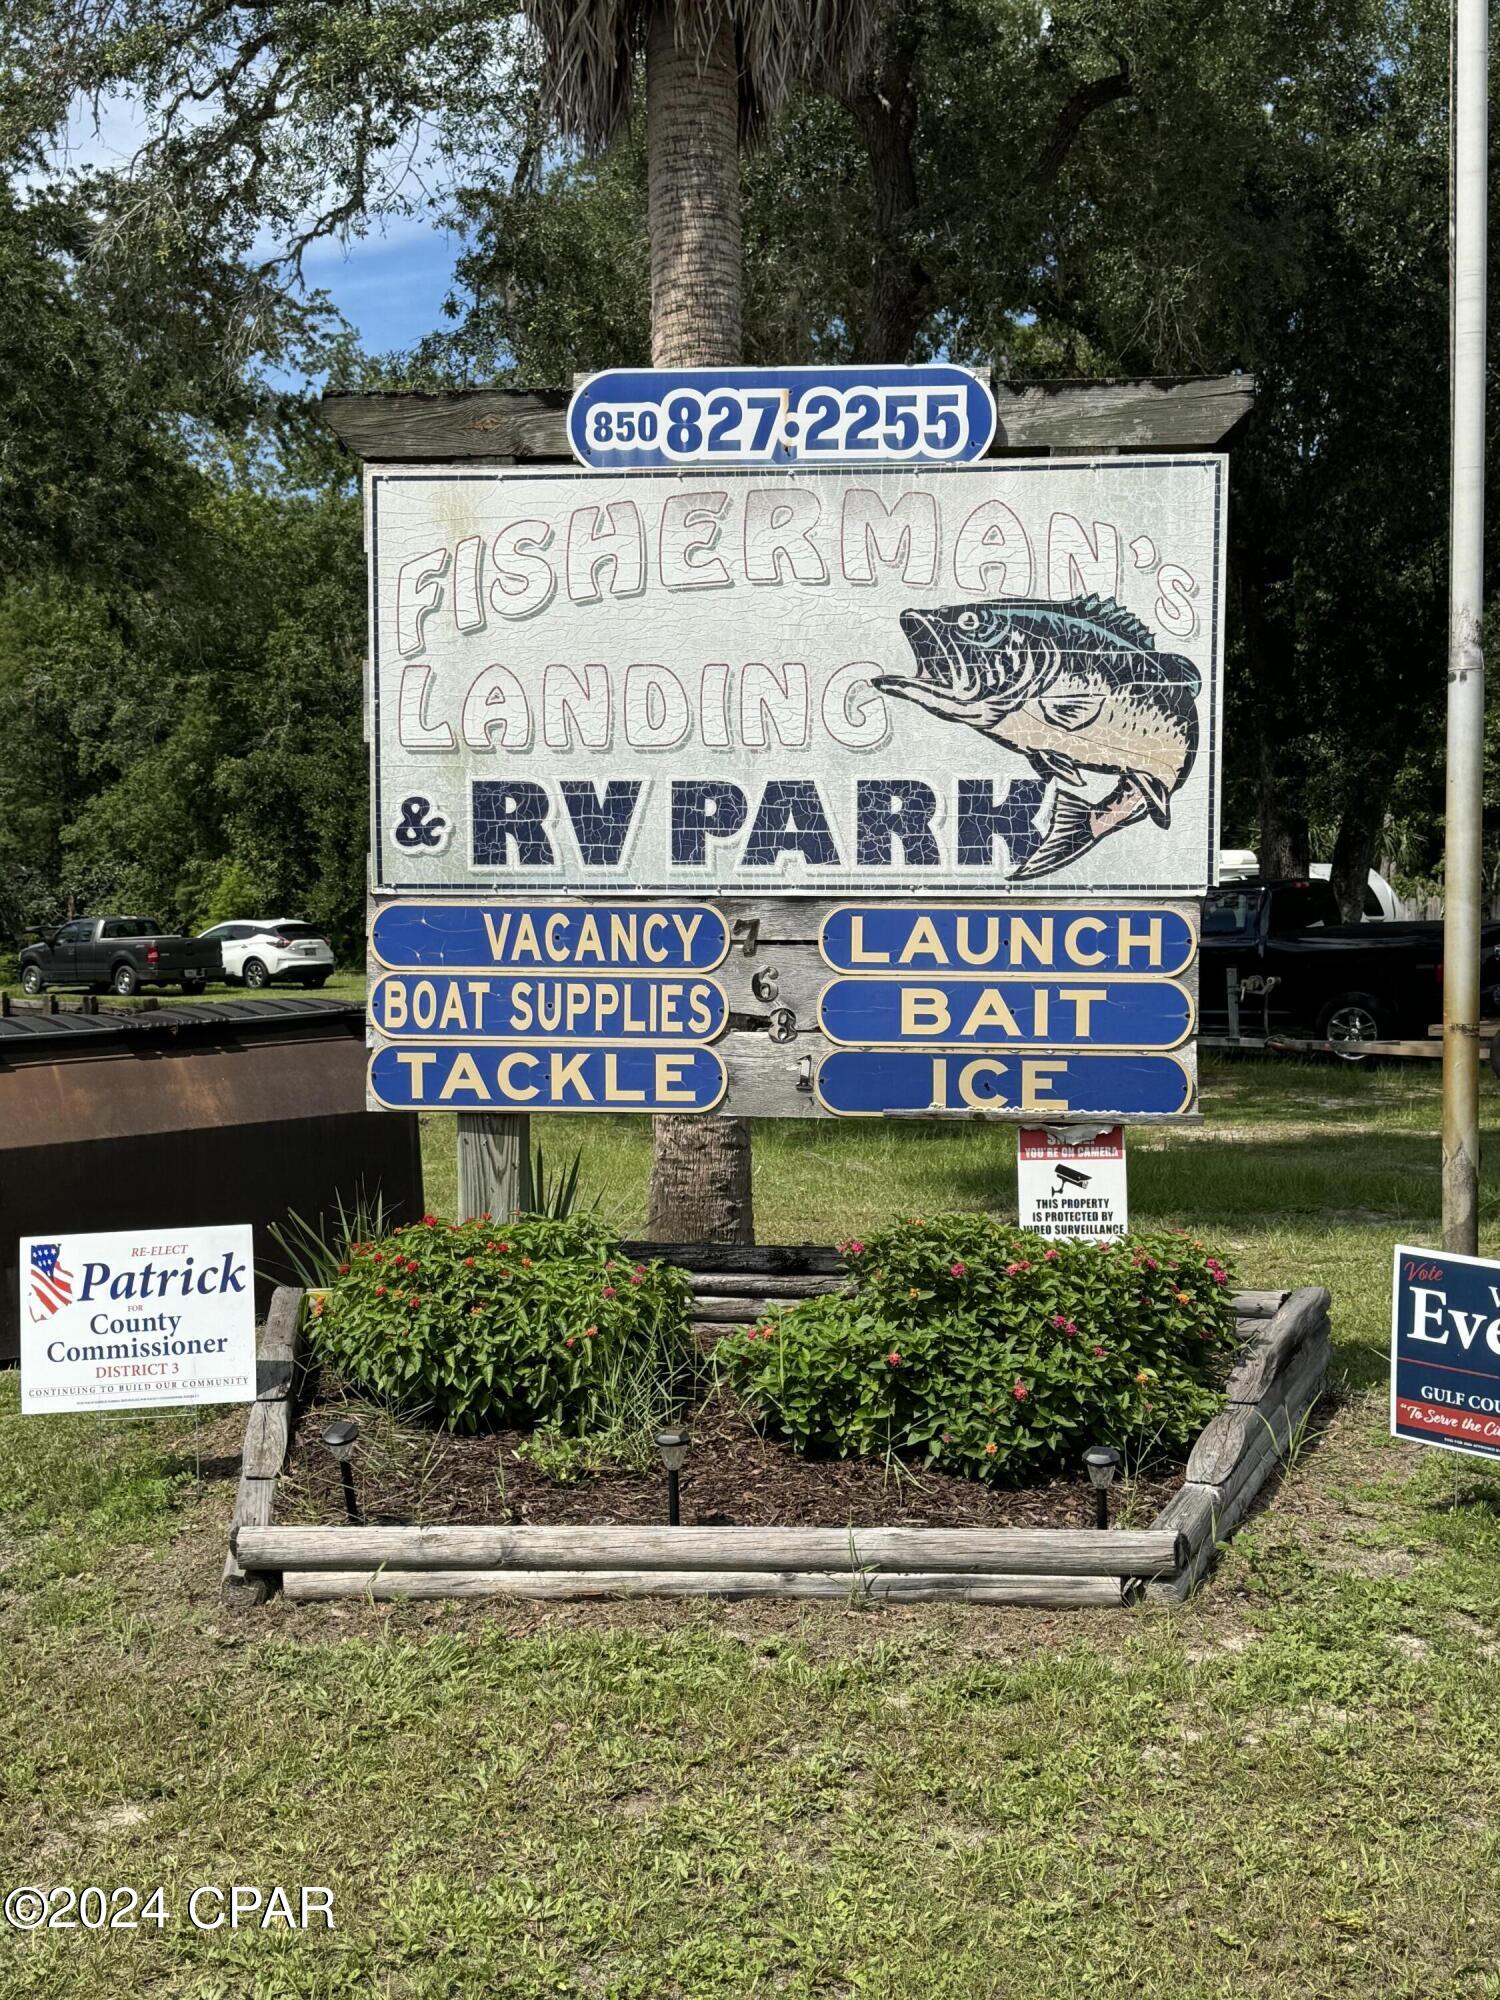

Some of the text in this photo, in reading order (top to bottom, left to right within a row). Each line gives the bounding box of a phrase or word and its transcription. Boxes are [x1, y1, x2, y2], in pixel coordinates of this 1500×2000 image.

[592, 410, 658, 442] 850
[396, 487, 1202, 656] FISHERMAN'S
[398, 660, 894, 753] LANDING
[394, 778, 1052, 867] & RV PARK
[482, 912, 704, 963] VACANCY
[850, 915, 1163, 967] LAUNCH
[383, 980, 713, 1034] BOAT SUPPLIES
[900, 987, 1108, 1038] BAIT
[396, 1051, 697, 1102] TACKLE
[931, 1058, 1069, 1111] ICE
[1024, 1146, 1119, 1158] YOU'RE ON CAMERA
[1032, 1211, 1114, 1222] IS PROTECTED BY
[1035, 1199, 1110, 1209] THIS PROPERTY
[1054, 1224, 1125, 1235] SURVEILLANCE
[131, 1244, 189, 1258] RE-ELECT
[77, 1251, 247, 1302] Patrick
[1404, 1260, 1444, 1282] Vote
[127, 1304, 144, 1313] FOR
[90, 1312, 183, 1337] County
[47, 1336, 228, 1363] Commissioner
[96, 1363, 180, 1379] DISTRICT 3
[29, 1376, 250, 1397] CONTINUING TO BUILD OUR COMMUNITY
[1420, 1385, 1466, 1406] GULF
[1423, 1409, 1459, 1428] Serve
[1461, 1417, 1483, 1433] the
